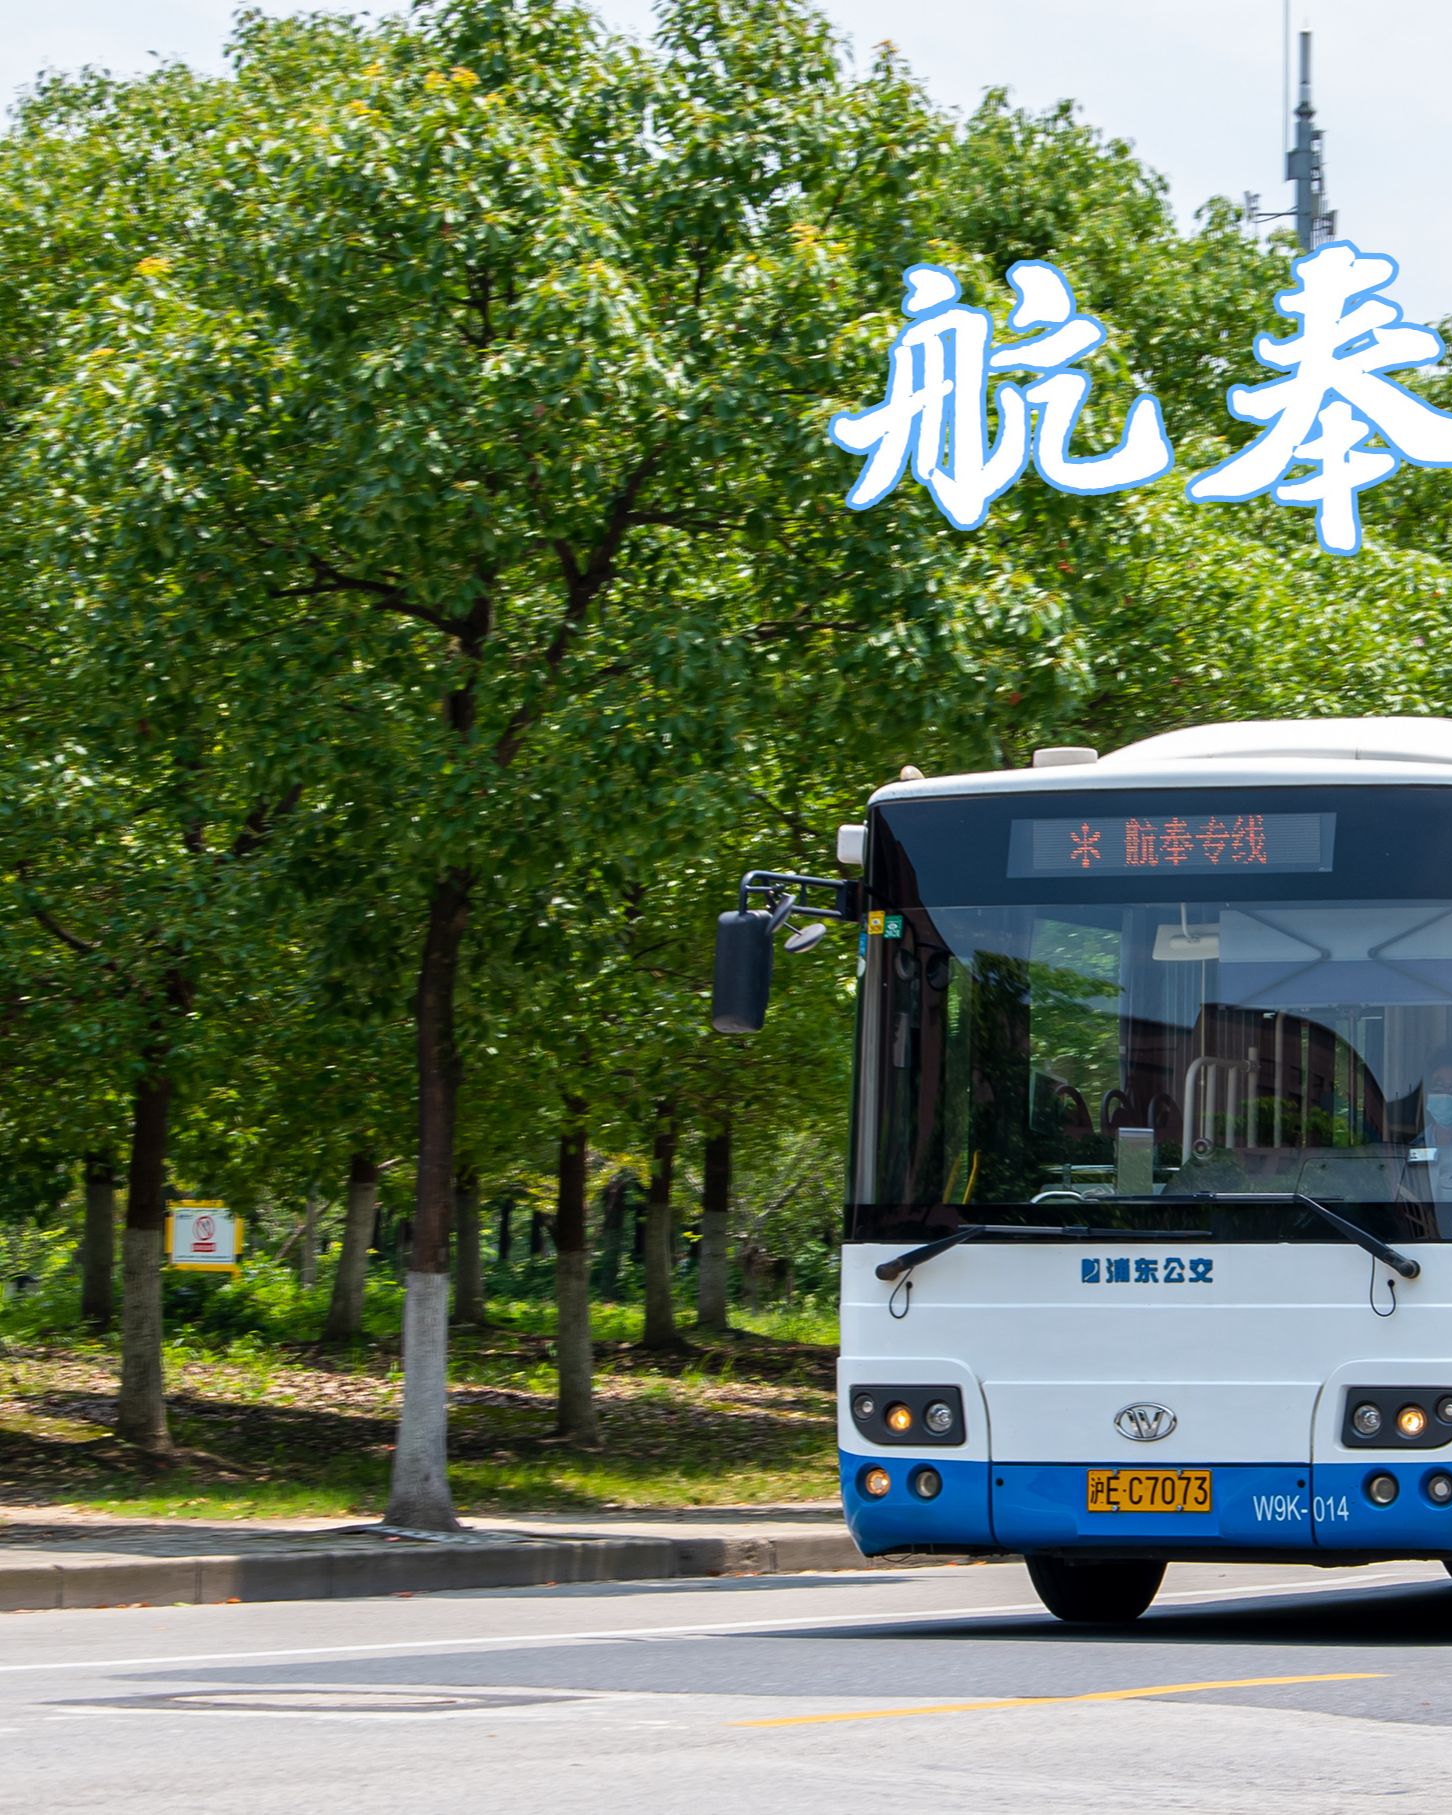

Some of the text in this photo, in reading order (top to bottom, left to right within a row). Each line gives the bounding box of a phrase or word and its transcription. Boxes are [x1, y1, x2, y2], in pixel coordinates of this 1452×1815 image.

[1124, 815, 1267, 866] 航奉专线
[1106, 1258, 1213, 1283] 浦东公交
[1253, 1495, 1349, 1522] W9K-014
